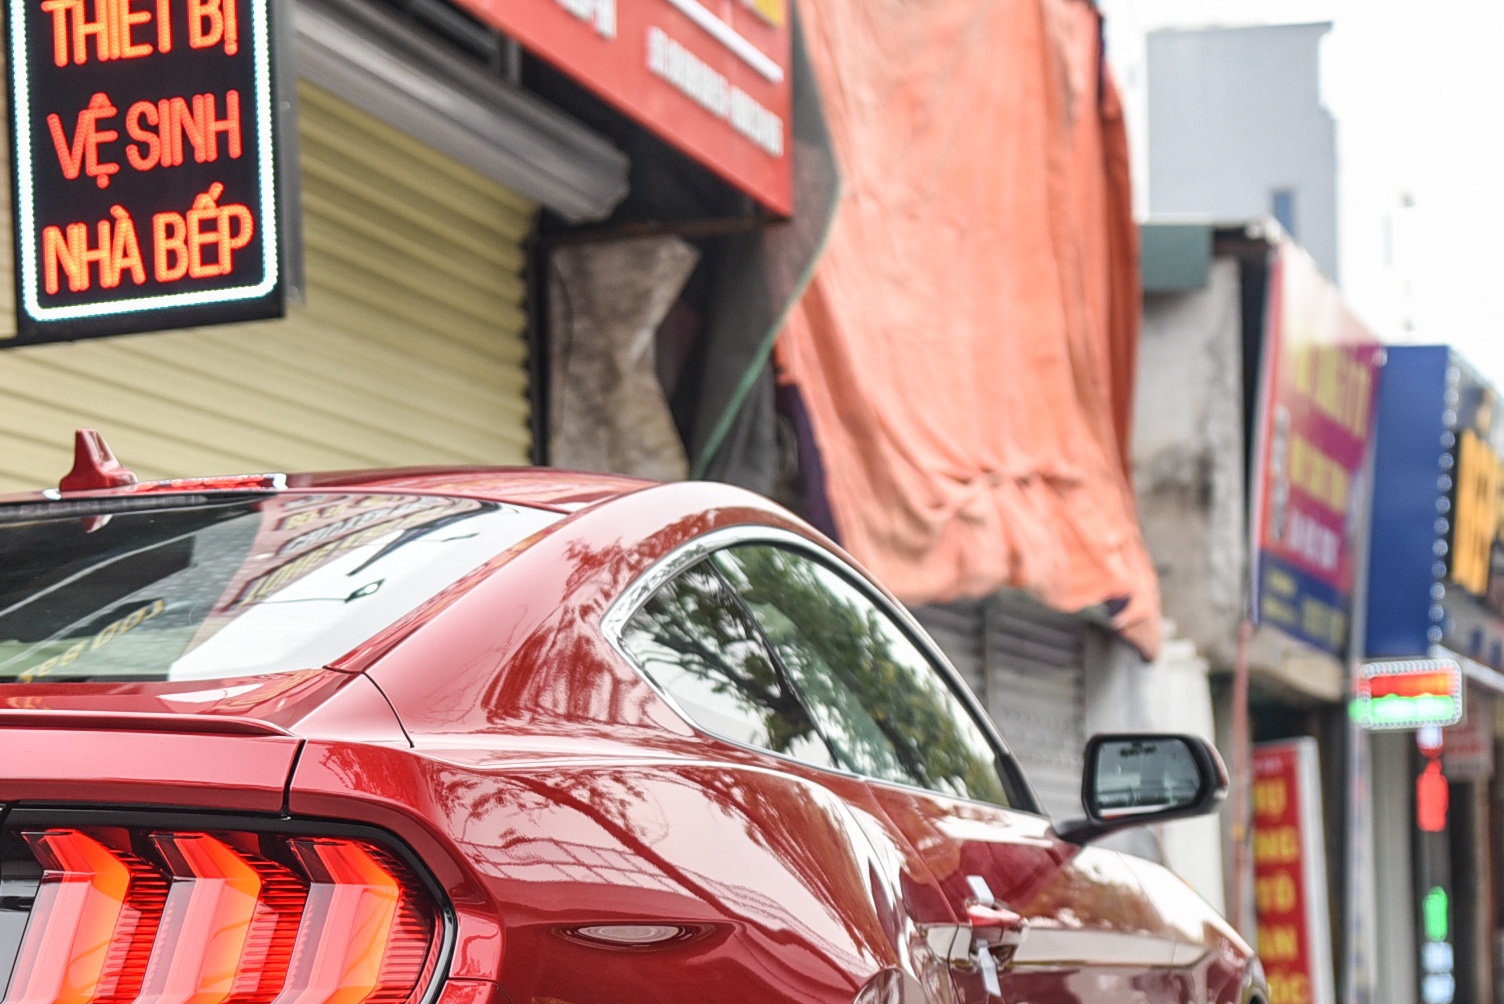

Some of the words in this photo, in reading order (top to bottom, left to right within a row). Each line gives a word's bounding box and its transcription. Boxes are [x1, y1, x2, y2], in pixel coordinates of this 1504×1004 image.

[188, 0, 239, 56] BỊ
[47, 92, 120, 189] VỆ
[125, 89, 243, 171] SINH
[42, 204, 147, 295] NHÀ
[152, 181, 255, 283] BẾP
